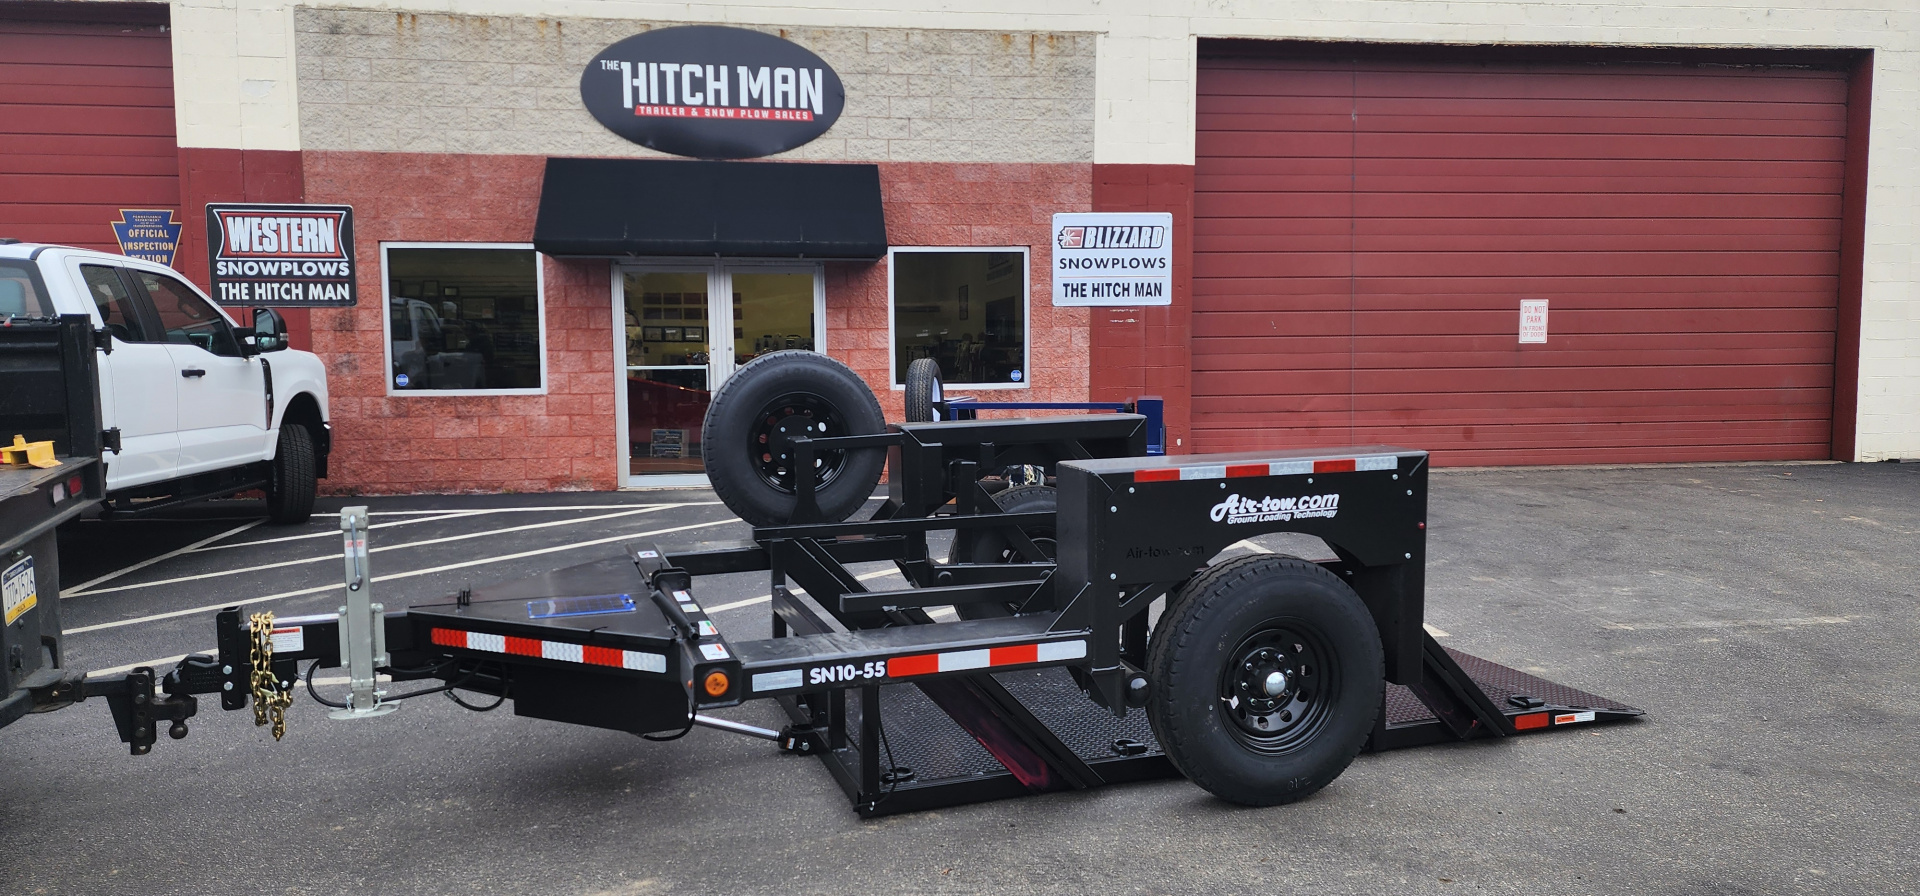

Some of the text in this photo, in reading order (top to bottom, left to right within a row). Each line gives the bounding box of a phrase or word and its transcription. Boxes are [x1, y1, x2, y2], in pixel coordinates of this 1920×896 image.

[600, 60, 620, 71] THE
[620, 61, 823, 115] HITCH MAN
[639, 106, 808, 120] TRAILER & SNOW PLOW SALES
[128, 228, 169, 238] OFFICIAL
[226, 216, 335, 253] WESTERN
[1083, 226, 1164, 249] BLIZZARD
[124, 241, 174, 251] INSPECTION
[216, 261, 350, 276] SNOWPLOWS
[1059, 257, 1166, 269] SNOWPLOWS
[219, 282, 350, 300] THE HITCH MAN
[1063, 282, 1162, 297] THE HITCH MAN
[1526, 315, 1542, 323] PARK
[1210, 493, 1340, 522] Air-tow.com
[1227, 510, 1338, 525] Ground Loading Technology
[1126, 545, 1205, 559] Air-towcom
[810, 661, 885, 684] SN10-55
